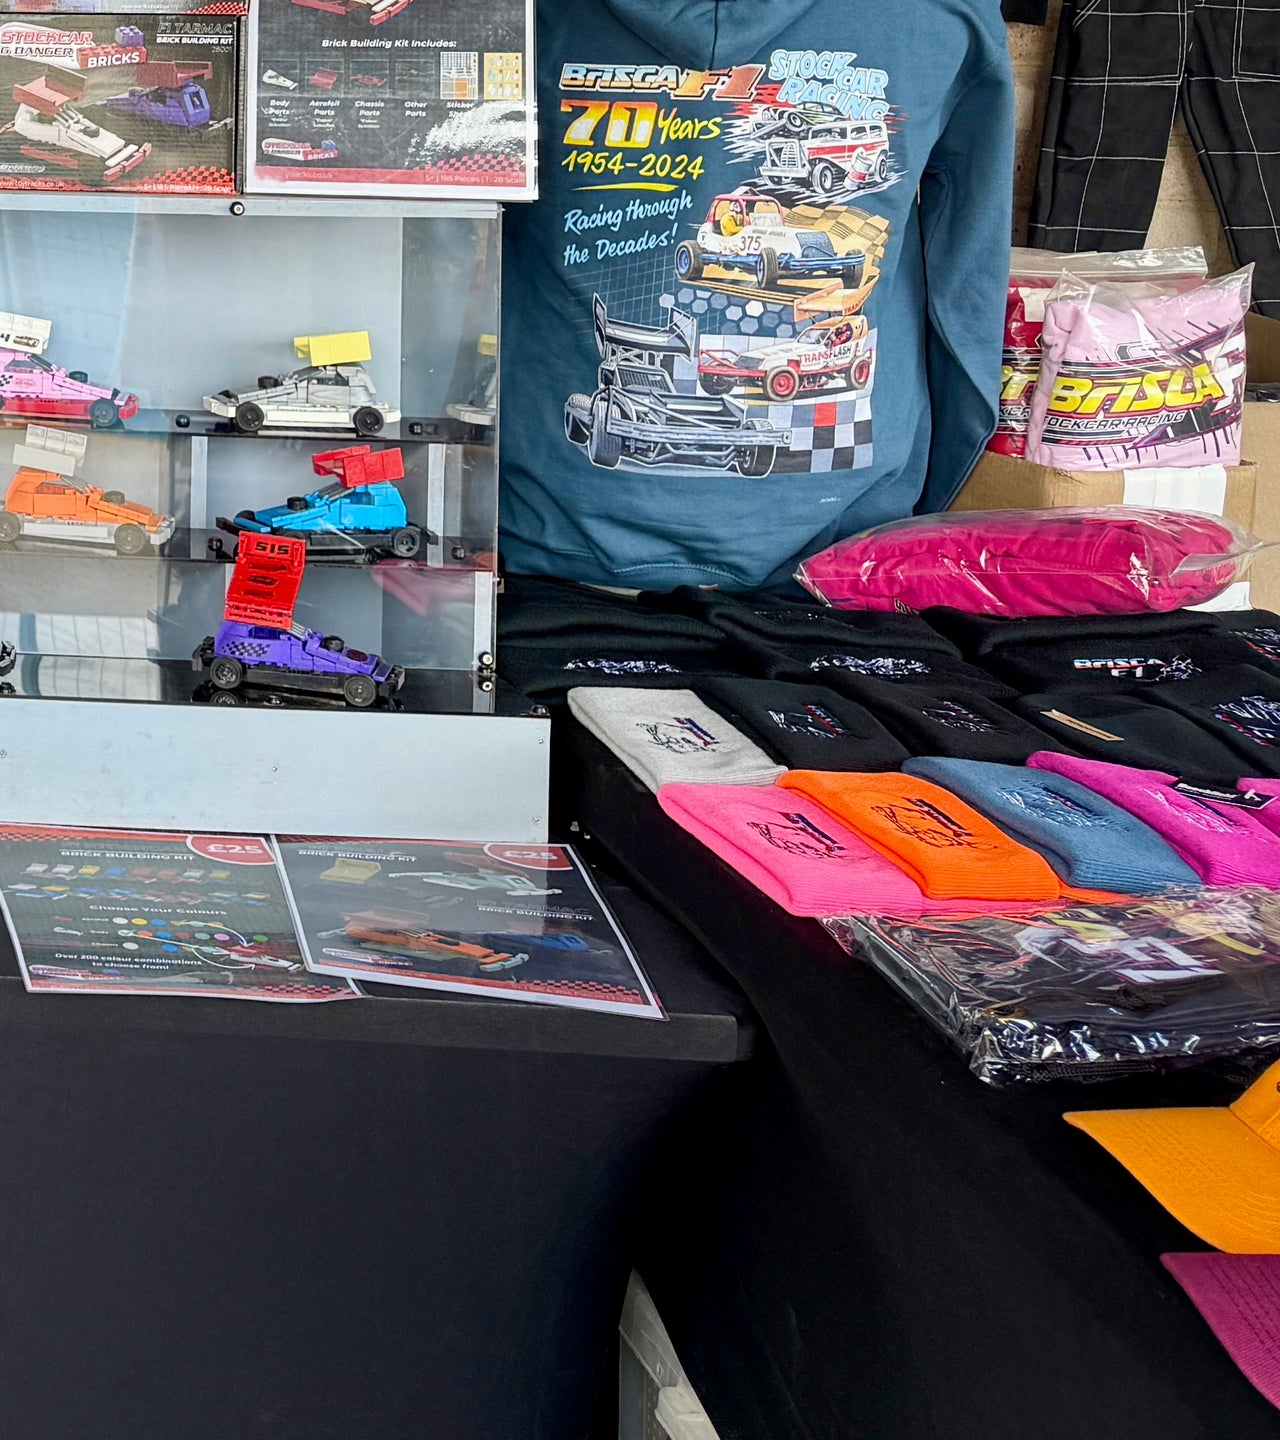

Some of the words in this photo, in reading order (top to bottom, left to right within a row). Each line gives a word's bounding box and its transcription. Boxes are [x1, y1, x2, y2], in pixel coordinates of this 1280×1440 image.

[0, 30, 93, 44] STOCKCAR
[156, 36, 179, 44] BRICK
[181, 36, 219, 45] BUILDING
[322, 39, 348, 48] Brick
[350, 39, 393, 50] Building
[394, 39, 409, 48] Kit
[411, 39, 457, 49] Includes:
[14, 47, 74, 57] BANGER
[87, 52, 140, 68] BRICKS
[770, 49, 857, 80] STOCK
[837, 67, 888, 97] CAR
[355, 100, 385, 108] Chassis
[404, 101, 427, 109] Other
[778, 79, 891, 122] RACING
[559, 98, 659, 148] 70
[657, 107, 723, 145] Years
[561, 150, 705, 180] 1954-2024
[564, 209, 624, 234] Racing
[625, 190, 694, 228] through
[563, 242, 590, 267] the
[594, 223, 678, 259] Decades!
[740, 234, 762, 251] 375
[1043, 416, 1125, 431] TOCKCAR
[1124, 409, 1186, 428] RACING
[205, 842, 264, 855] £25
[105, 851, 180, 861] BUILDING
[89, 904, 138, 913] Choose
[139, 905, 174, 914] Your
[175, 907, 228, 916] Colours
[54, 952, 79, 960] Over
[137, 956, 203, 966] combinations
[105, 962, 139, 970] choose
